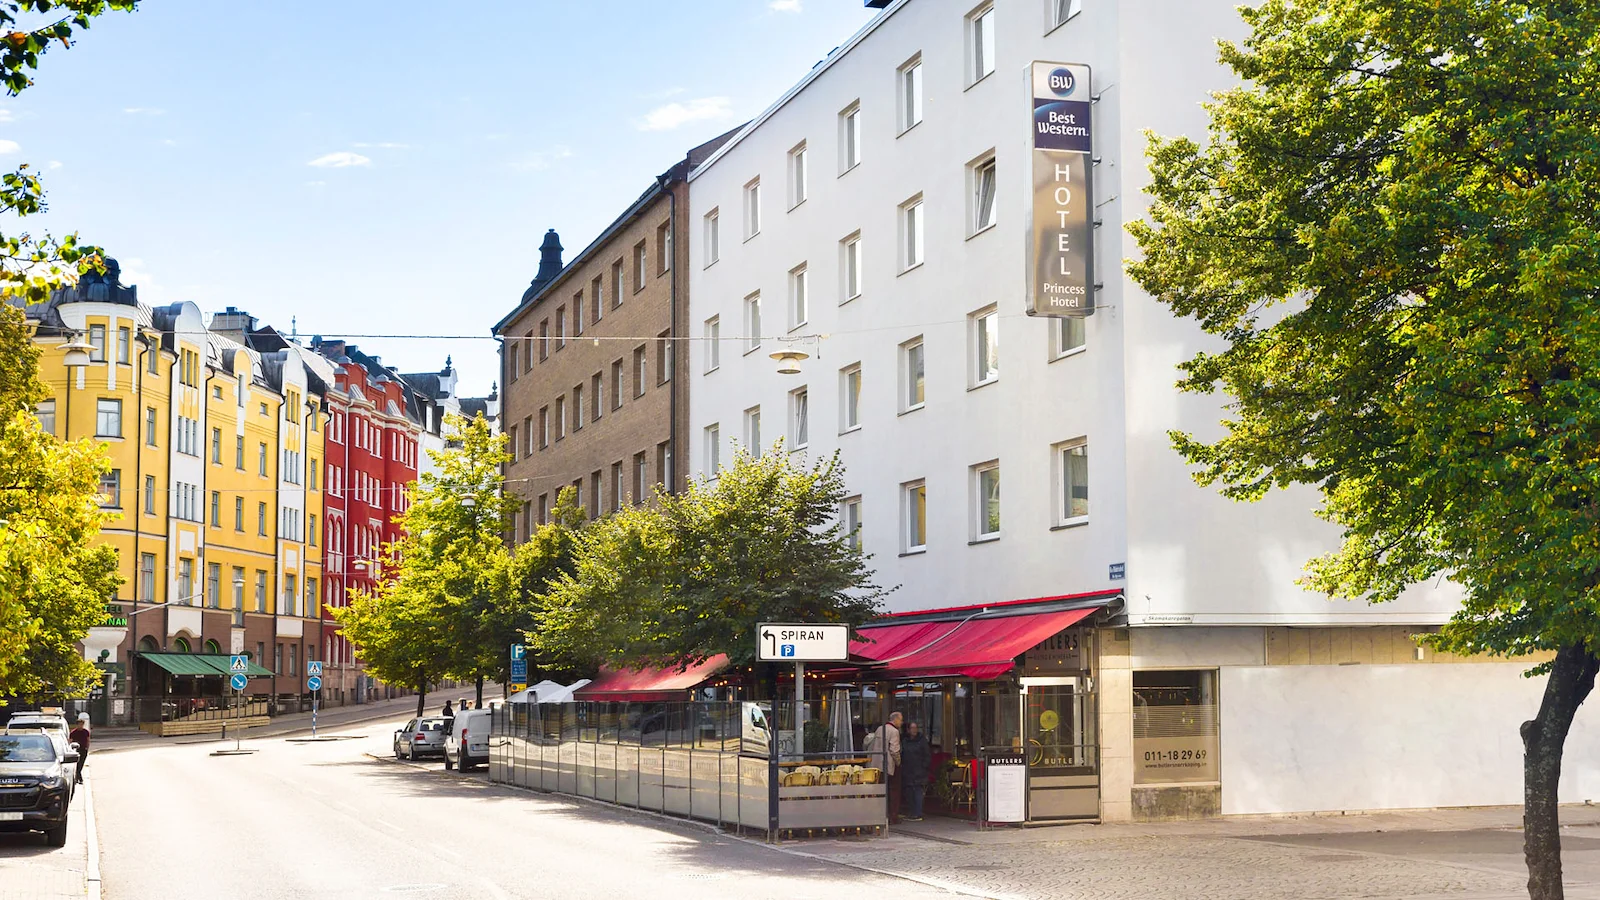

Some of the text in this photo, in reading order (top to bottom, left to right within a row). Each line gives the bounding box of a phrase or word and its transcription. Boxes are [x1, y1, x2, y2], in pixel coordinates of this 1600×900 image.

[1051, 75, 1073, 89] BW
[1049, 111, 1075, 124] Best
[1054, 163, 1071, 276] HOTEL
[1043, 282, 1085, 295] Princess
[1050, 296, 1079, 308] Hotel
[106, 617, 127, 626] NAN
[781, 630, 824, 641] SPIRAN
[1044, 757, 1085, 765] BUTLES
[1144, 749, 1207, 761] 011-18 29 69
